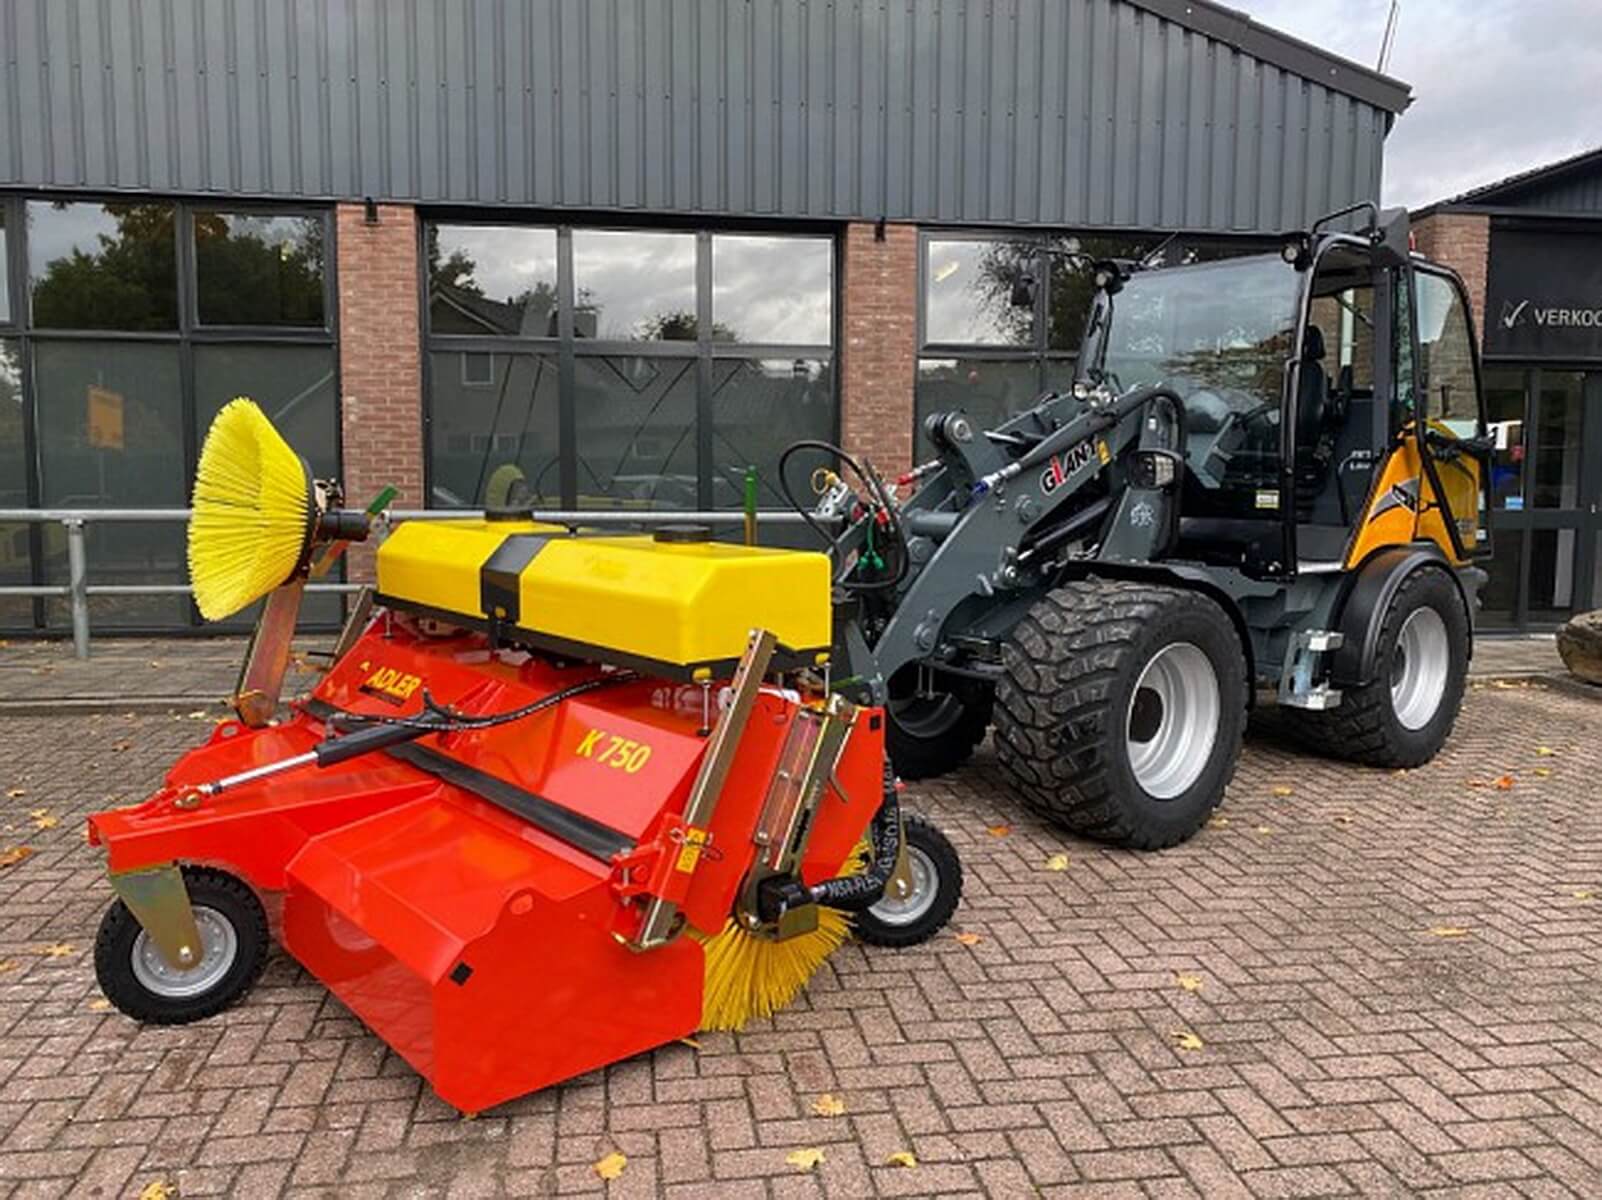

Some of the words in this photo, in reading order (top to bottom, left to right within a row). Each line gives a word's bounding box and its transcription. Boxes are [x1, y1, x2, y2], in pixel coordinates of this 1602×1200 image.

[1040, 437, 1099, 496] GIANT
[365, 666, 422, 700] ADLER
[575, 729, 607, 758] K
[597, 735, 652, 774] 750
